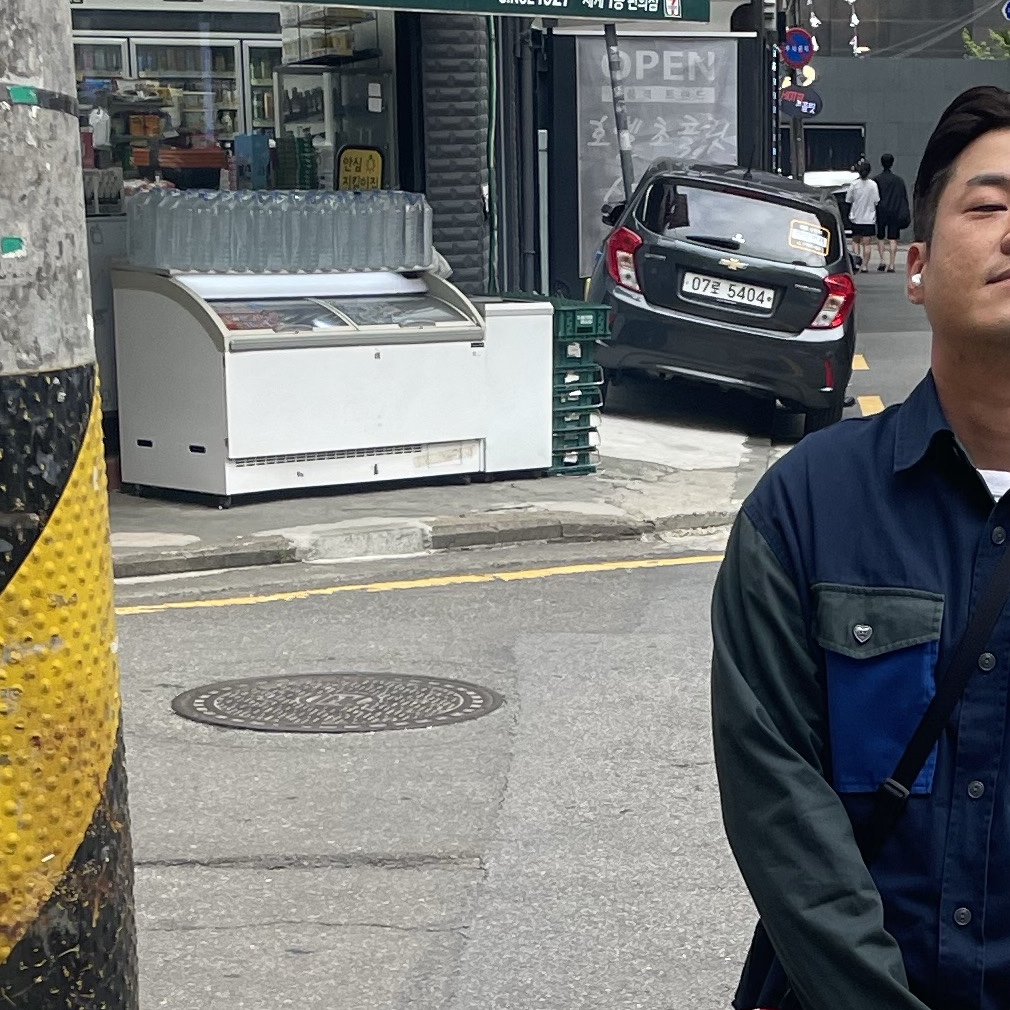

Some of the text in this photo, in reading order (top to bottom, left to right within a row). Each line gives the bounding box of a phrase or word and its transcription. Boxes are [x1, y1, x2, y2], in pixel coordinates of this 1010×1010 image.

[601, 50, 715, 81] OPEN
[342, 156, 362, 172] 안심
[691, 276, 765, 304] 07로 5404
